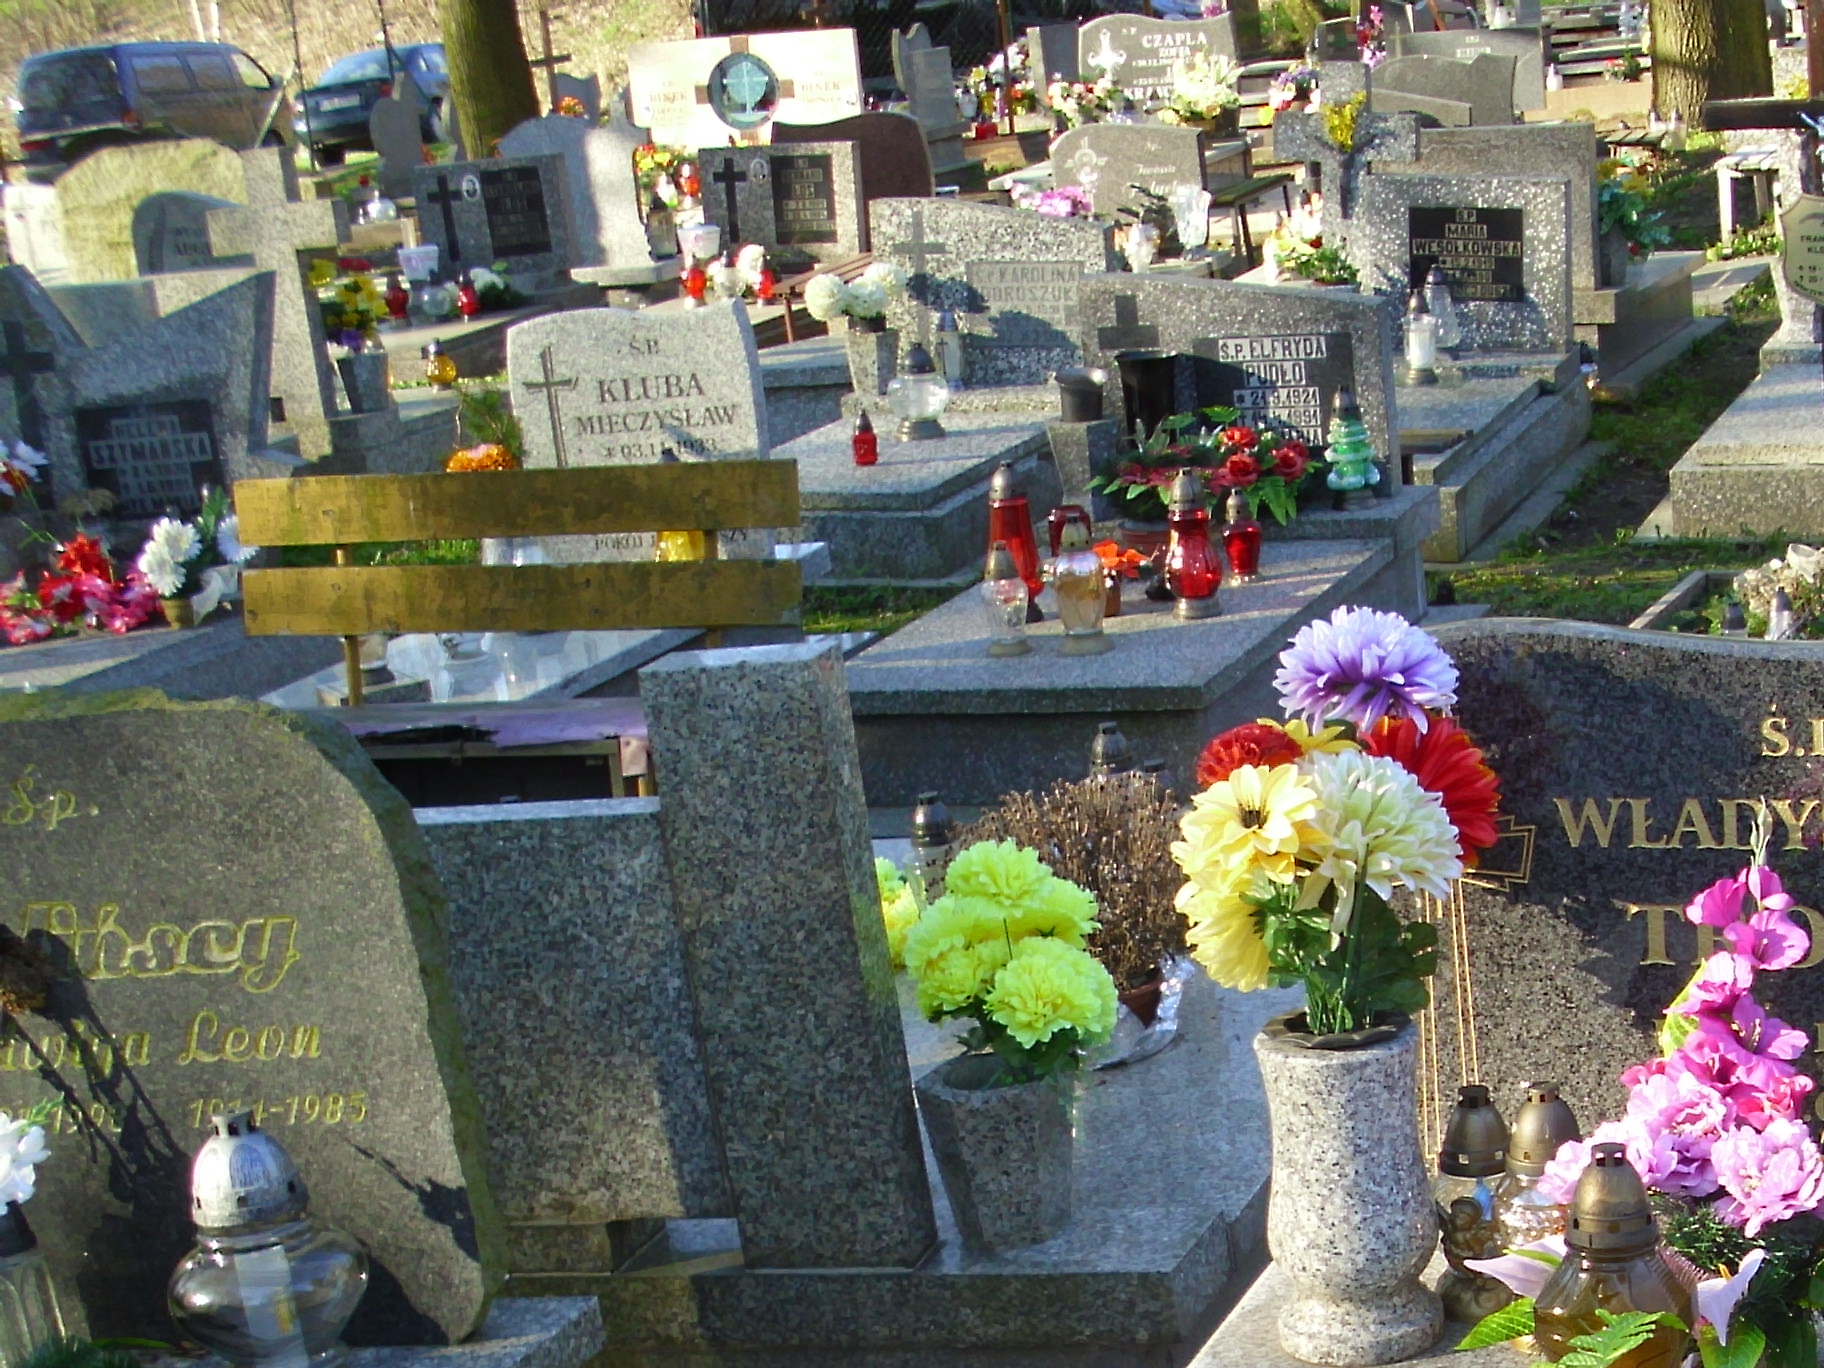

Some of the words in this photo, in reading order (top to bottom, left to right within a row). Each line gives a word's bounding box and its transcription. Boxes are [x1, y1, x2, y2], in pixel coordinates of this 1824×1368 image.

[1142, 31, 1208, 48] CZAPLA
[1446, 224, 1487, 238] MARIA
[1248, 337, 1326, 359] ELFRYDA
[599, 373, 706, 404] KLUBA
[575, 403, 739, 437] MIECZYSŁAW
[177, 1009, 323, 1066] Leon
